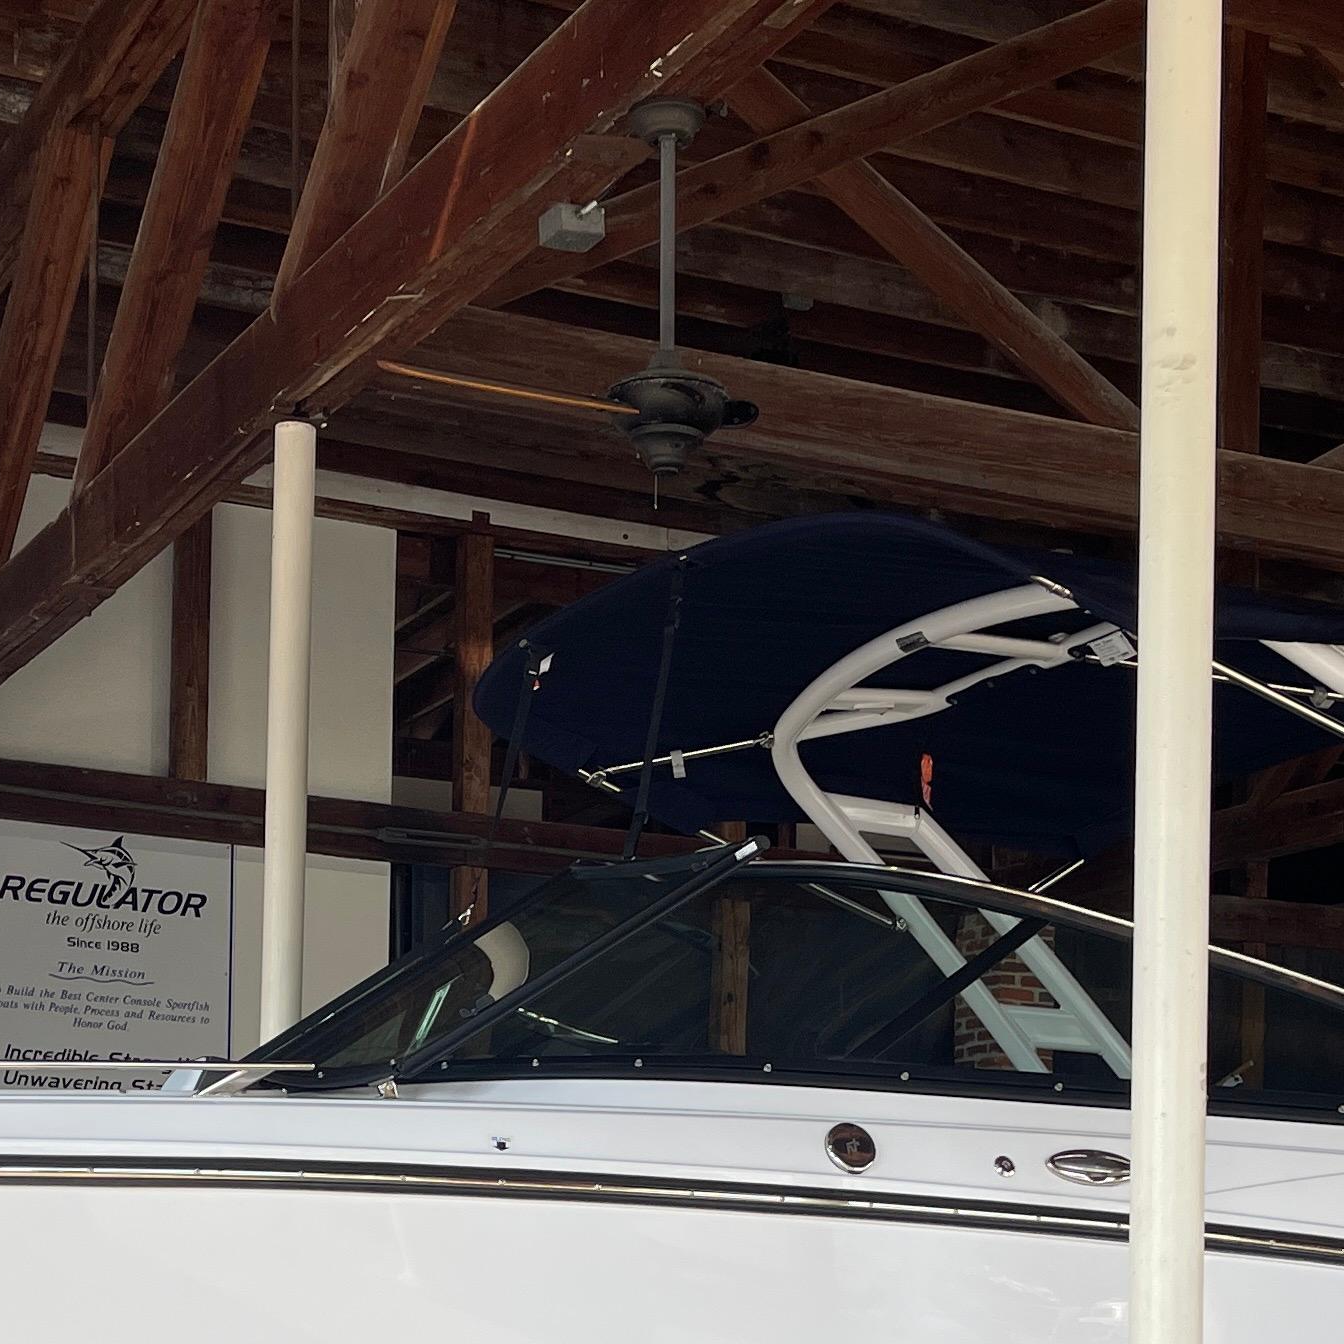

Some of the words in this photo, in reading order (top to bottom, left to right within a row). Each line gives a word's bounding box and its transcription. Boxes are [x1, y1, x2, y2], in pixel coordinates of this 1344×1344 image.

[45, 909, 69, 926] the
[74, 912, 134, 933] offshore
[138, 917, 161, 938] life
[66, 936, 101, 949] Since
[107, 939, 139, 953] 1988
[57, 961, 84, 974] The
[90, 964, 145, 979] Mission
[6, 984, 35, 996] Build
[39, 988, 55, 998] the
[59, 989, 81, 1000] Best
[85, 991, 119, 1003] Center
[122, 994, 161, 1007] Console
[165, 998, 209, 1011] Sportfish
[23, 1000, 44, 1011] with
[83, 1004, 119, 1017] Process
[123, 1009, 143, 1018] and
[147, 1009, 195, 1023] Resources
[200, 1016, 209, 1024] to
[72, 1016, 103, 1029] Honor
